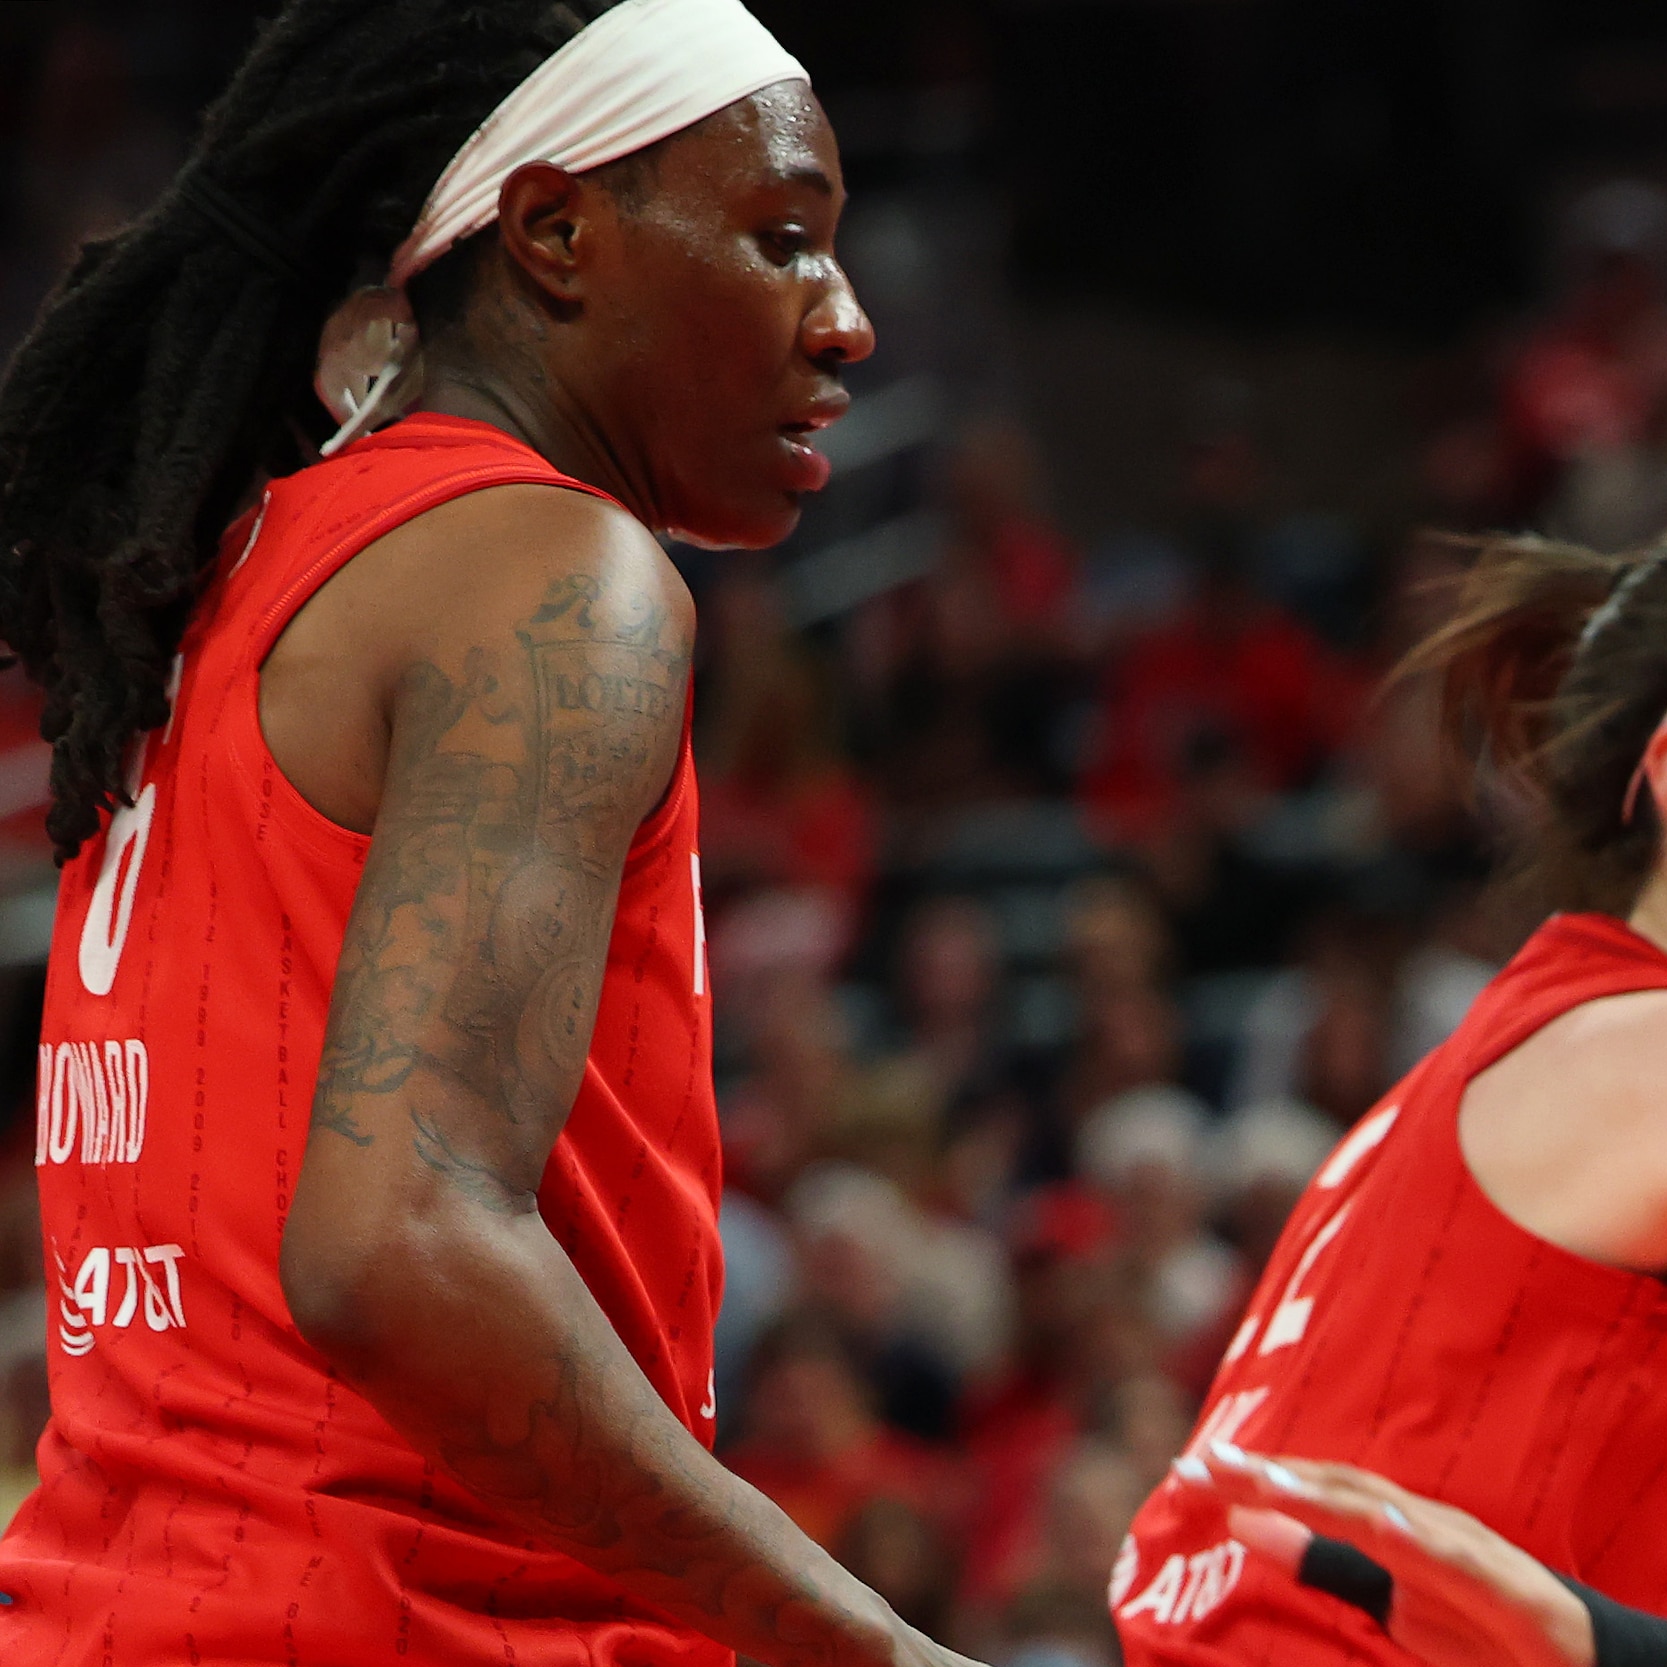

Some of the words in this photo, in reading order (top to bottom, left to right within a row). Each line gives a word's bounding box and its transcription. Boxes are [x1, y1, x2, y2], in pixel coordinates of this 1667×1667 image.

[79, 782, 155, 996] 0
[275, 912, 295, 1130] BASKETBALL
[35, 1037, 149, 1171] HOWARD
[275, 1150, 289, 1236] CHOS
[74, 1242, 186, 1333] AT&T
